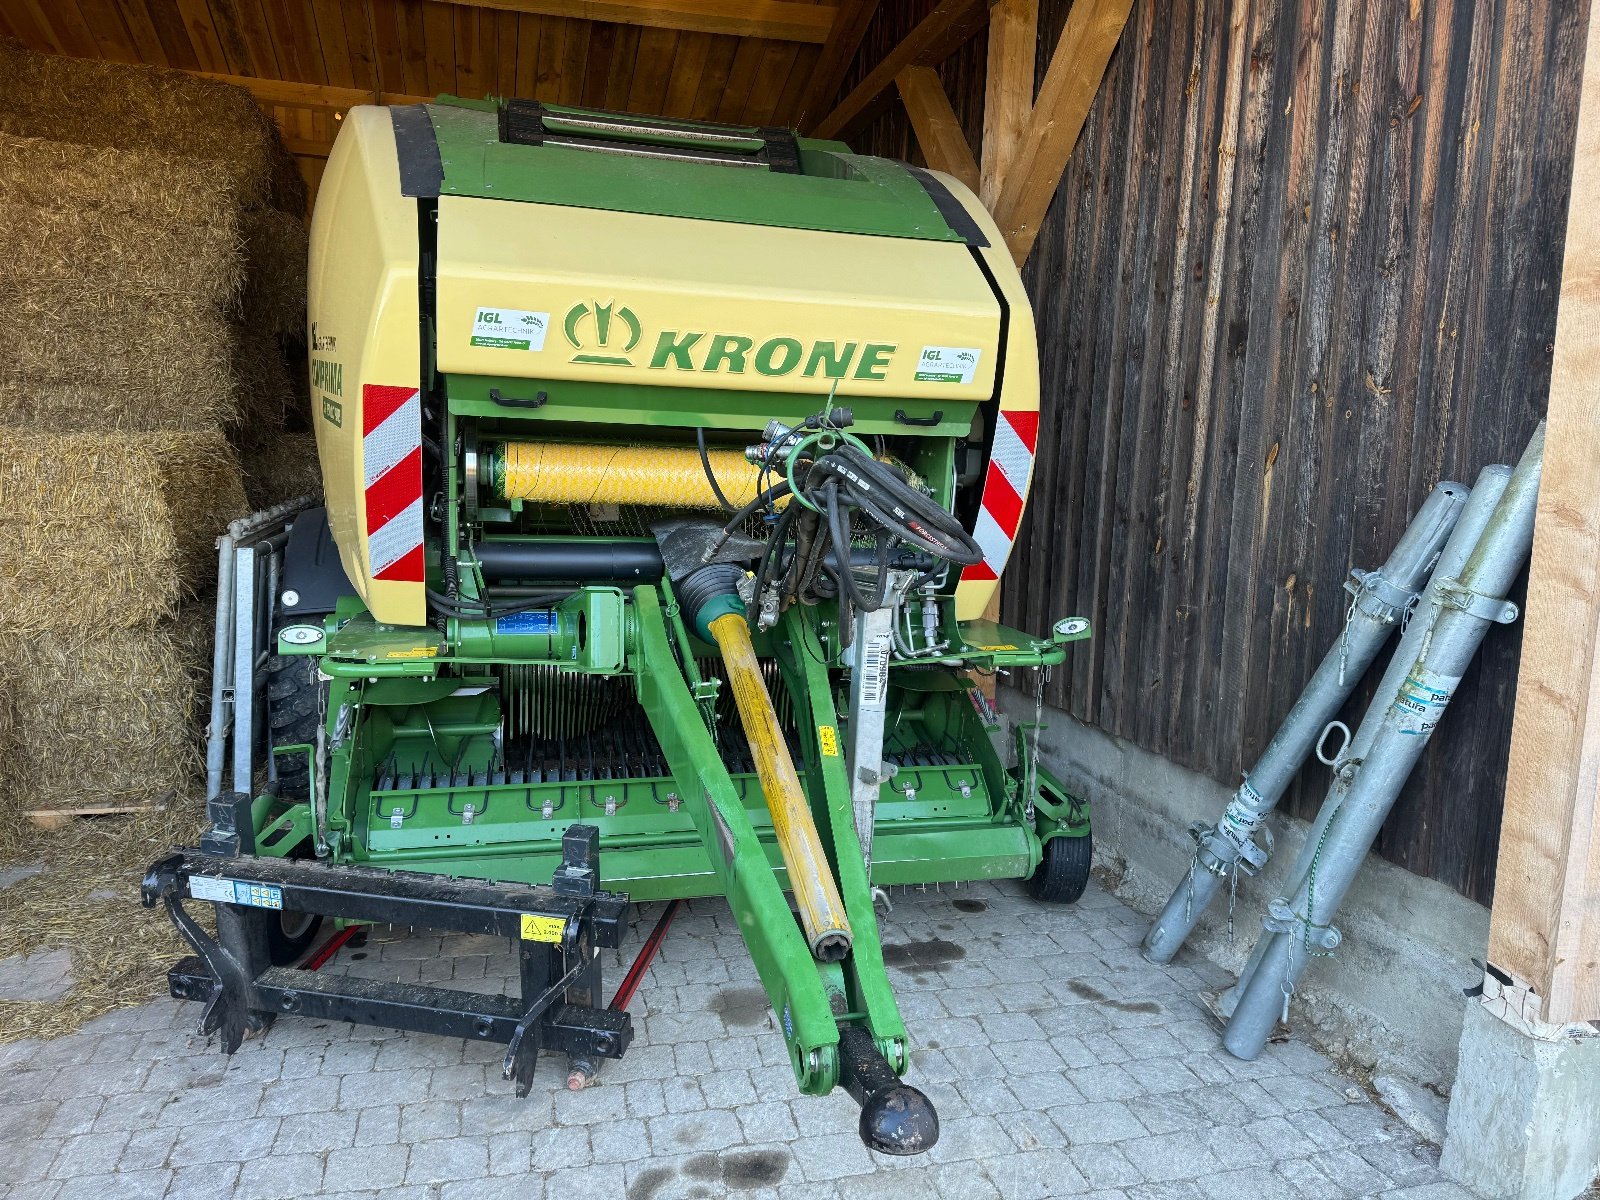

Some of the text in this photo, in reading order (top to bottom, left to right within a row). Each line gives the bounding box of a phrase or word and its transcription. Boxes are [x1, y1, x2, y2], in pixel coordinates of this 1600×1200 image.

[477, 311, 503, 324] IGL
[648, 328, 898, 381] KRONE
[922, 349, 942, 361] IGL
